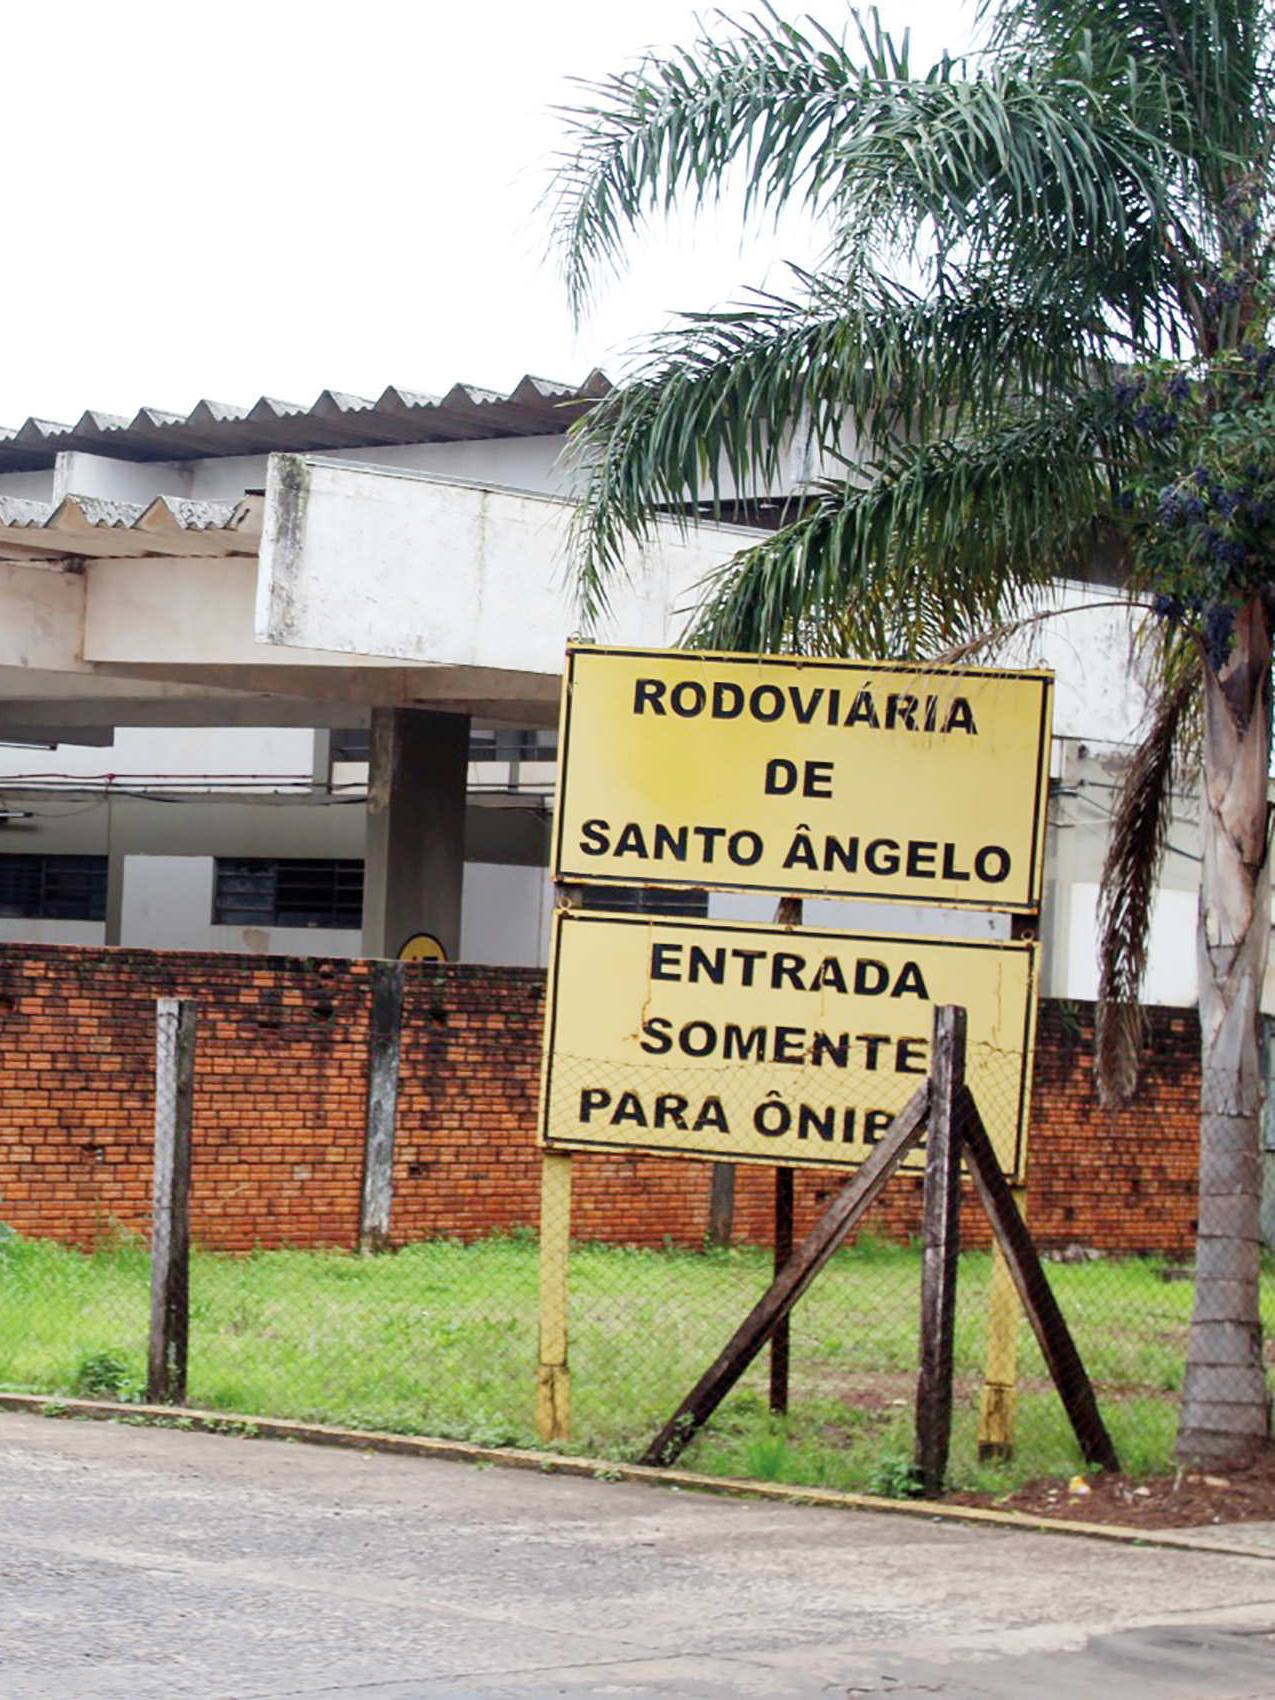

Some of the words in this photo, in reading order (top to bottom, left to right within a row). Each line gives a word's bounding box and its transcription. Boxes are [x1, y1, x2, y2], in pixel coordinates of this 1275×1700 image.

[633, 678, 978, 735] RODOVIÁRIA
[764, 758, 834, 799] DE
[579, 819, 764, 866] SANTO
[782, 823, 1012, 884] ÂNGELO
[650, 942, 930, 1000] ENTRADA
[640, 1016, 928, 1075] SOMENTE
[579, 1088, 730, 1134] PARA
[753, 1090, 928, 1149] ÔNIB
